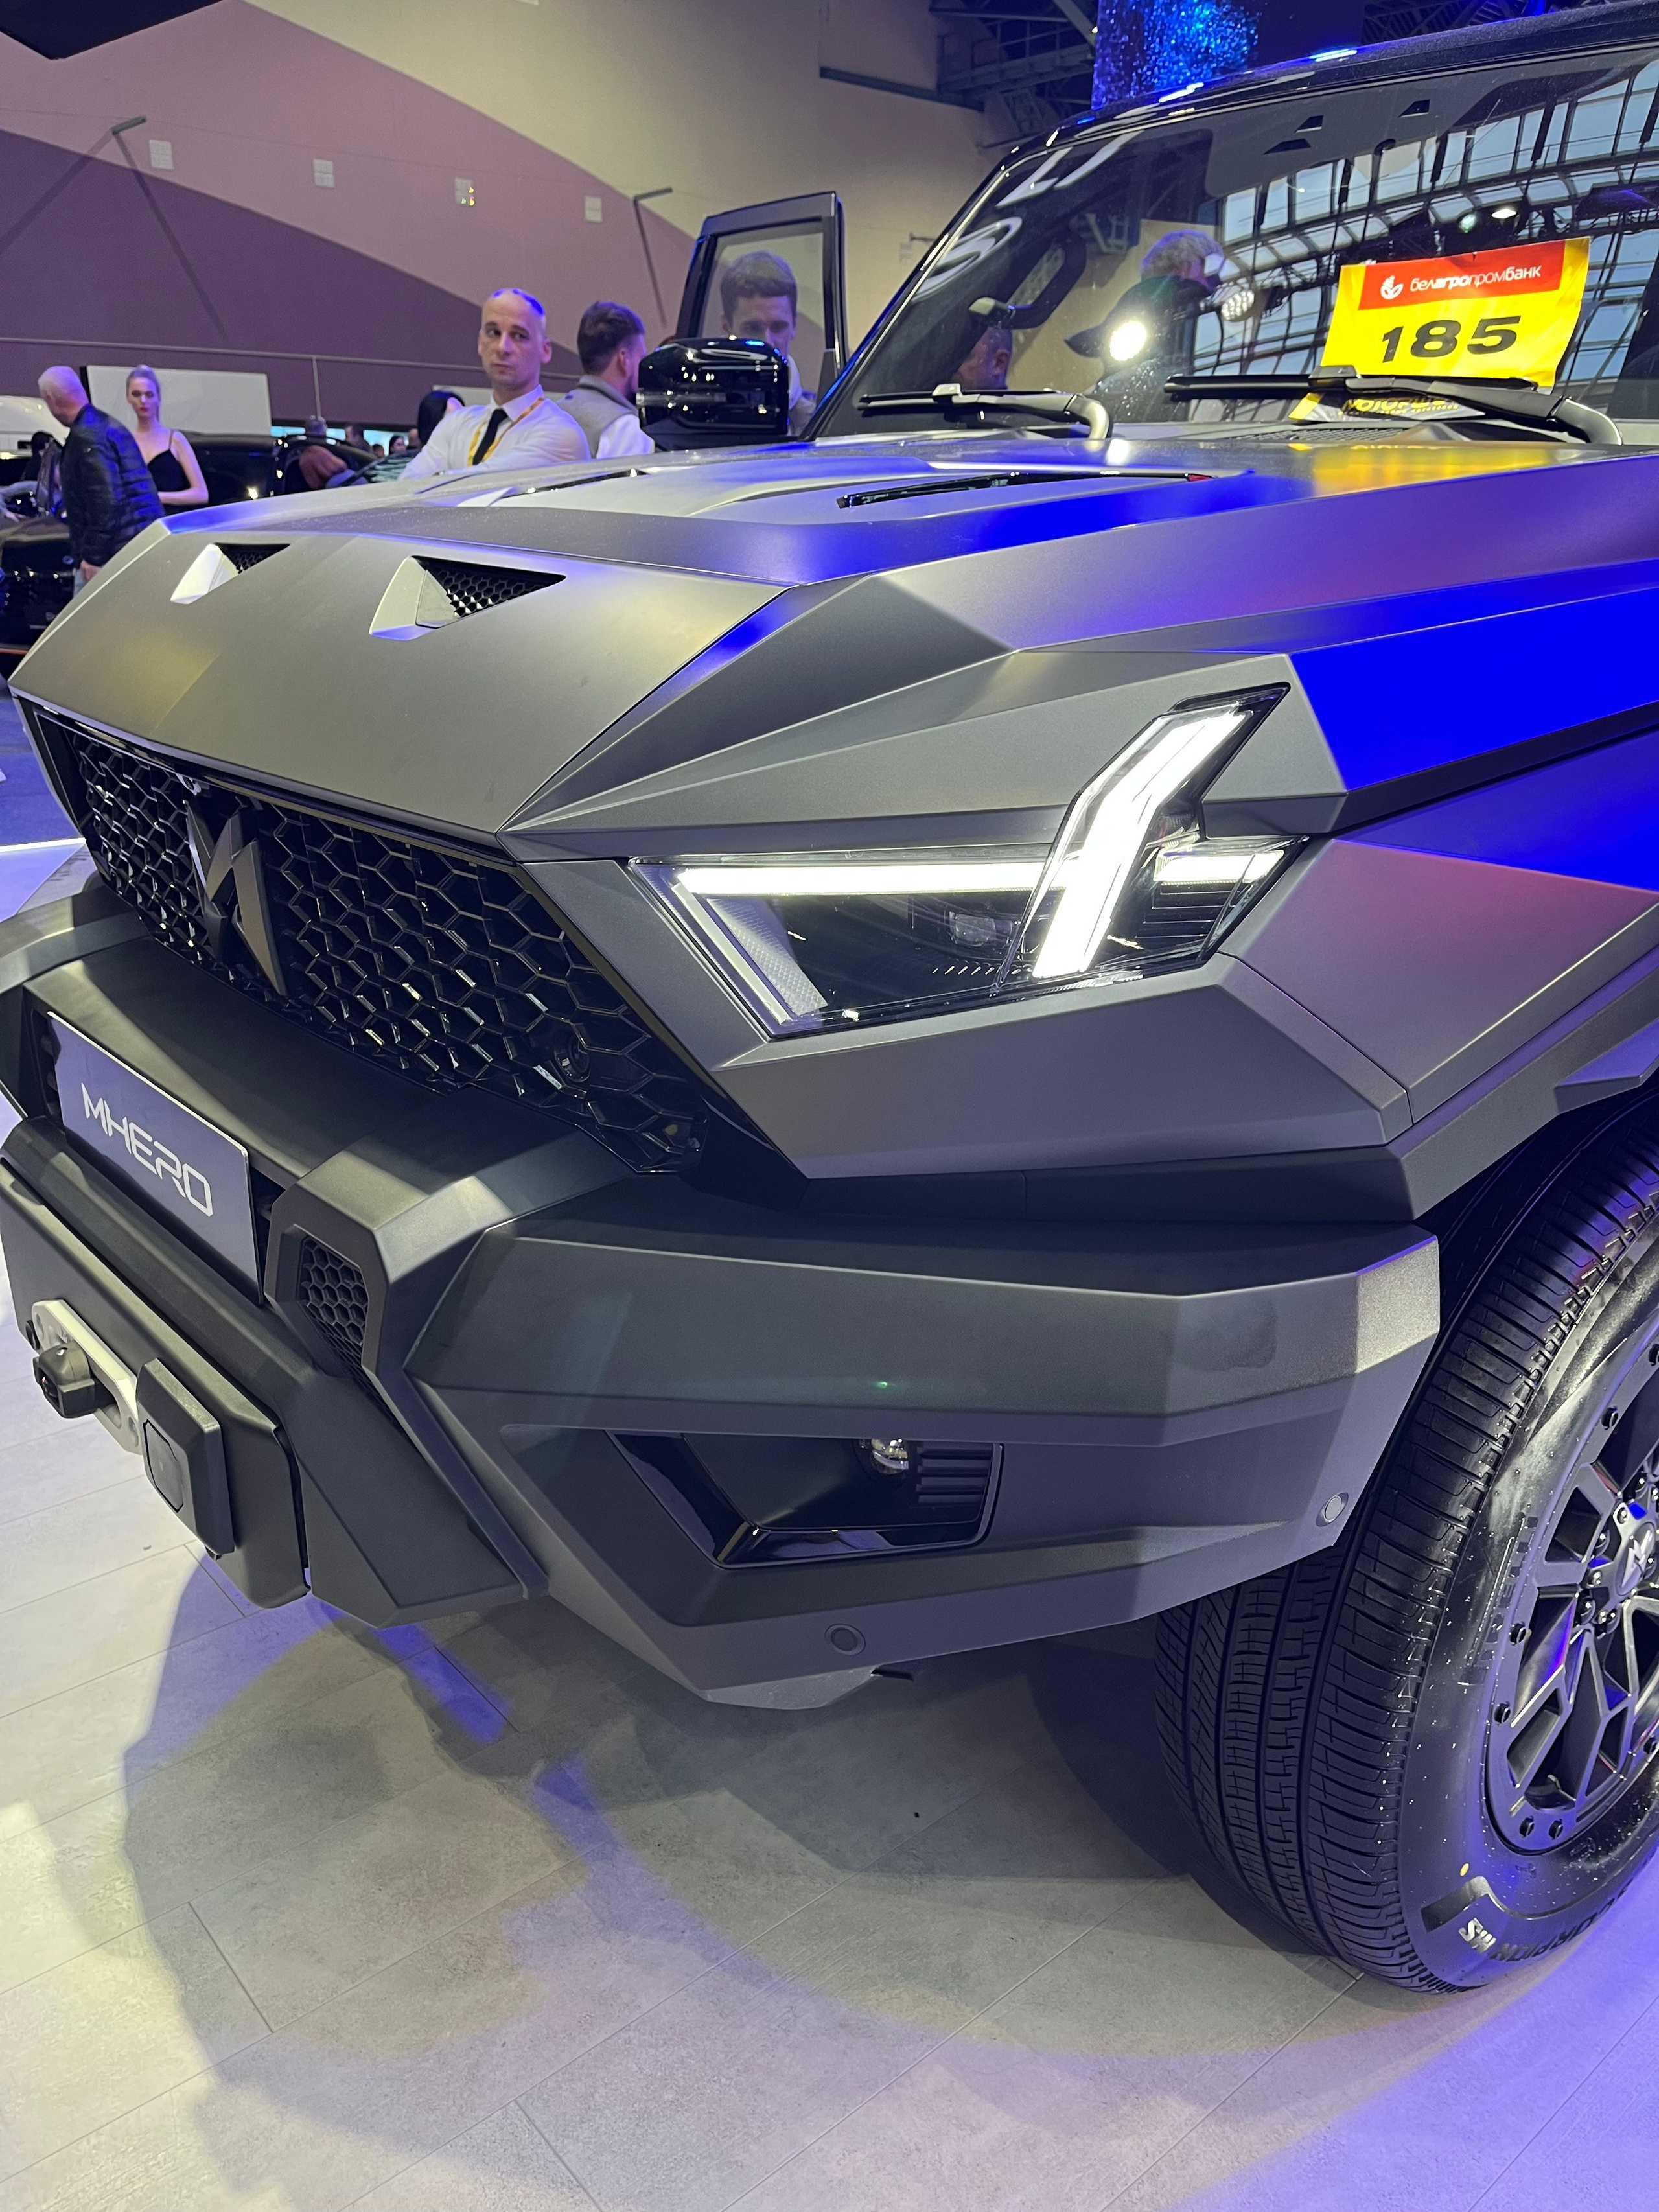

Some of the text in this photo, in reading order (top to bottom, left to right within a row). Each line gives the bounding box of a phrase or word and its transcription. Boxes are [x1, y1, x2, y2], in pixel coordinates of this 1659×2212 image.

[1410, 264, 1542, 292] белагропромбанк
[1382, 316, 1522, 362] 185
[81, 1082, 214, 1217] MHERO
